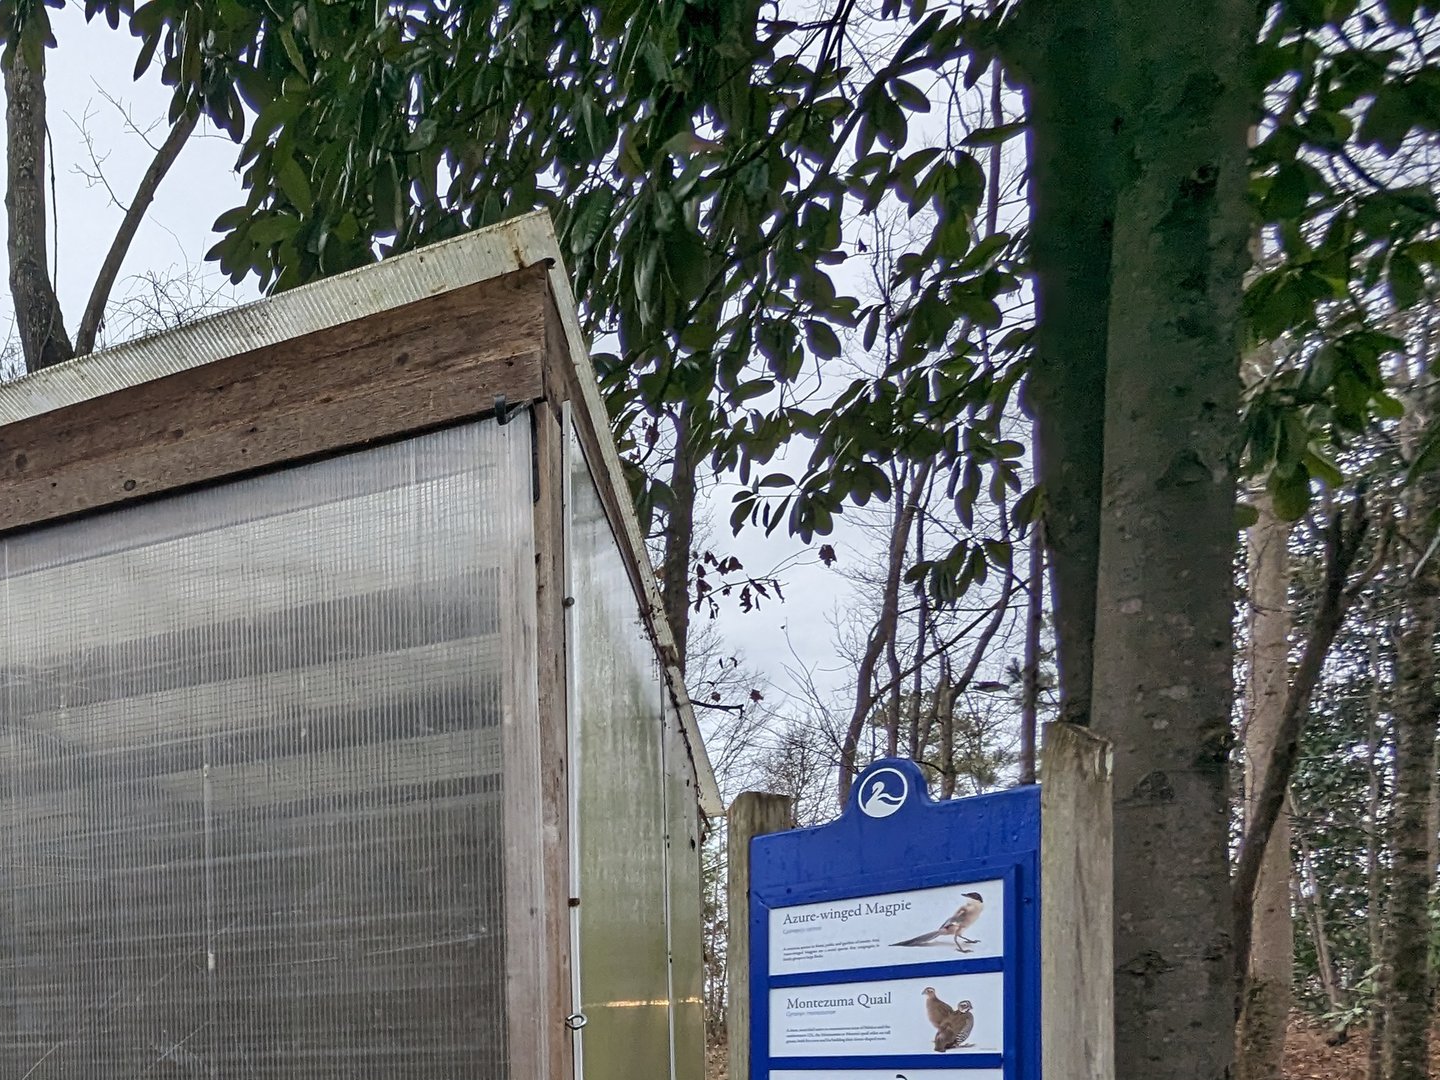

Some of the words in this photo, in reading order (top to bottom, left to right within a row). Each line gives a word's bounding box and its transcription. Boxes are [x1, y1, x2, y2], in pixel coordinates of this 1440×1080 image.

[783, 903, 862, 925] Azure-winged
[864, 899, 912, 918] Magpie
[786, 996, 854, 1010] Montezuma
[857, 991, 892, 1009] Quail
